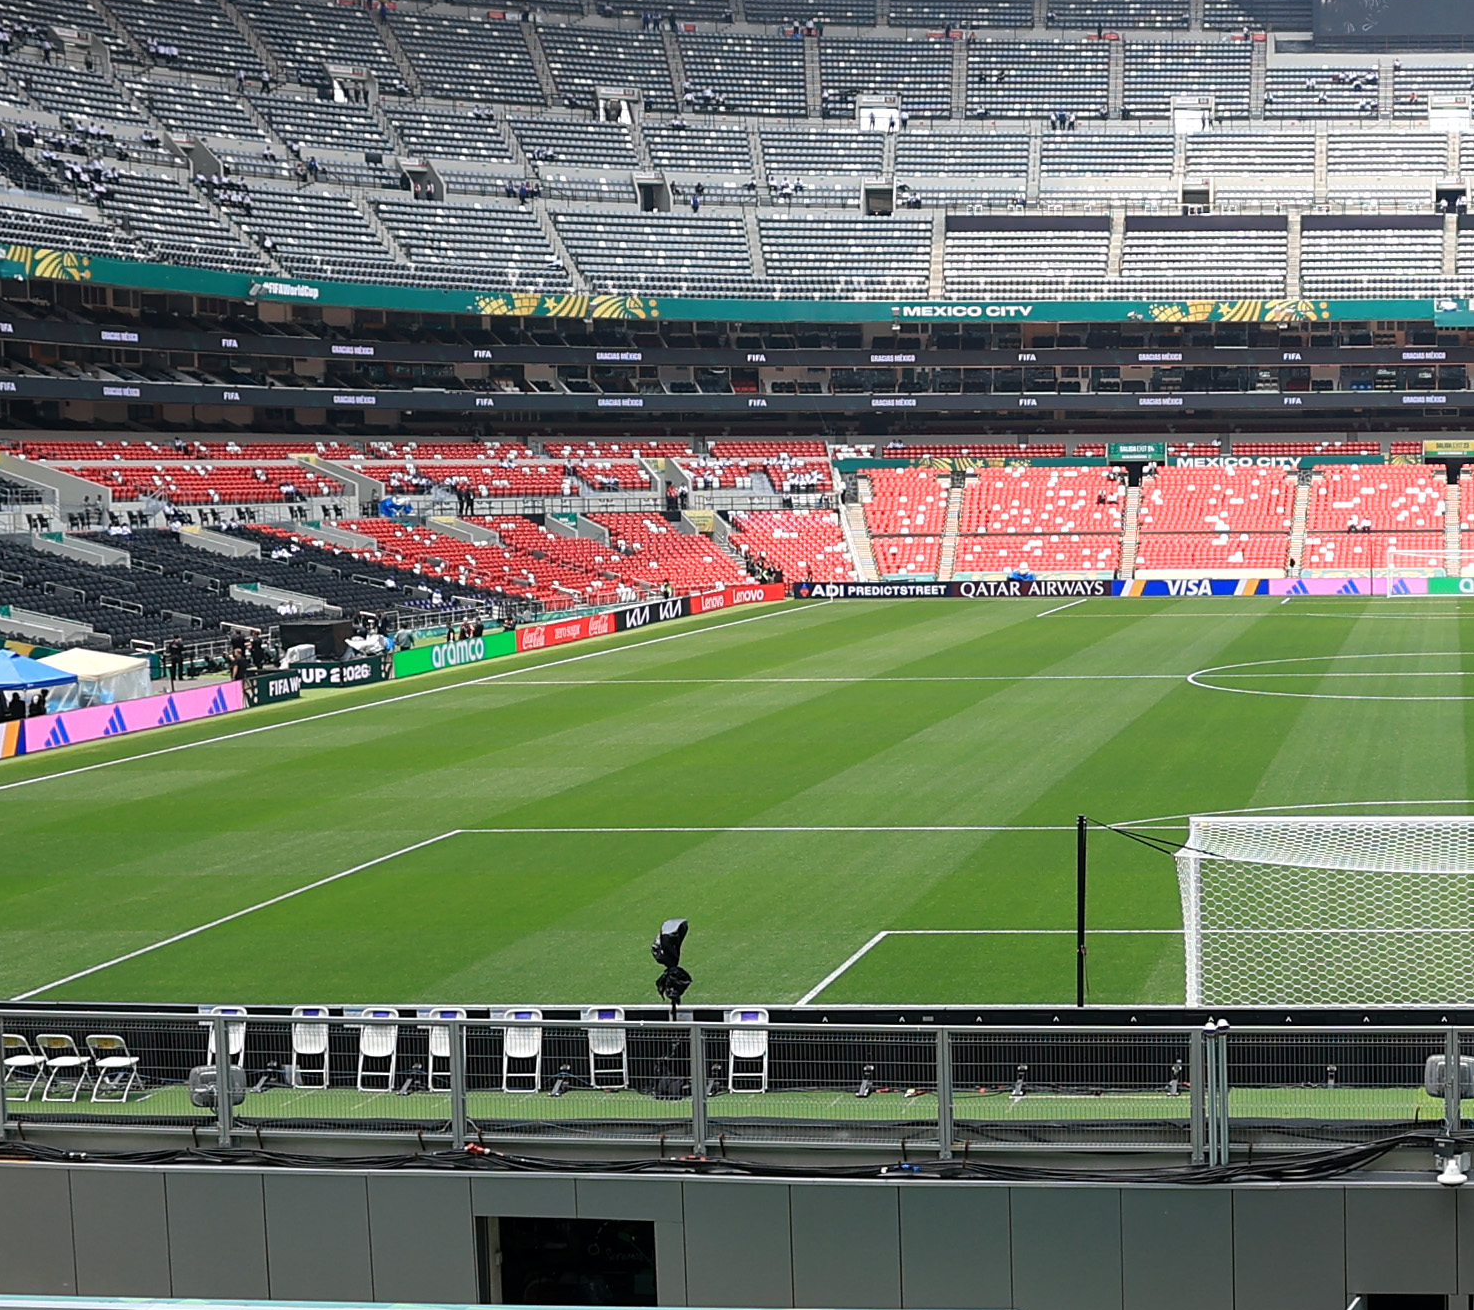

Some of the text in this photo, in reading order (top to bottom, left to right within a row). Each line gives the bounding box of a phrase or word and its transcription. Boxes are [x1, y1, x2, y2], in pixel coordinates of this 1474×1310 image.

[902, 306, 1033, 317] MEXICO CITY
[1283, 353, 1302, 361] FIFA
[1176, 457, 1302, 468] MEXICO CITY
[732, 588, 765, 603] Lenovo
[811, 584, 947, 598] ADI PREDICTSTREET
[959, 580, 1105, 597] QATAR AIRWAYS
[1166, 579, 1213, 596] VISA
[659, 599, 682, 620] KIA
[701, 595, 725, 610] Lenovo
[625, 606, 650, 628] KIA
[522, 626, 545, 650] Coca-Cola
[588, 615, 609, 637] Coca-Cola
[432, 638, 485, 669] aramco
[269, 679, 289, 697] FIFA
